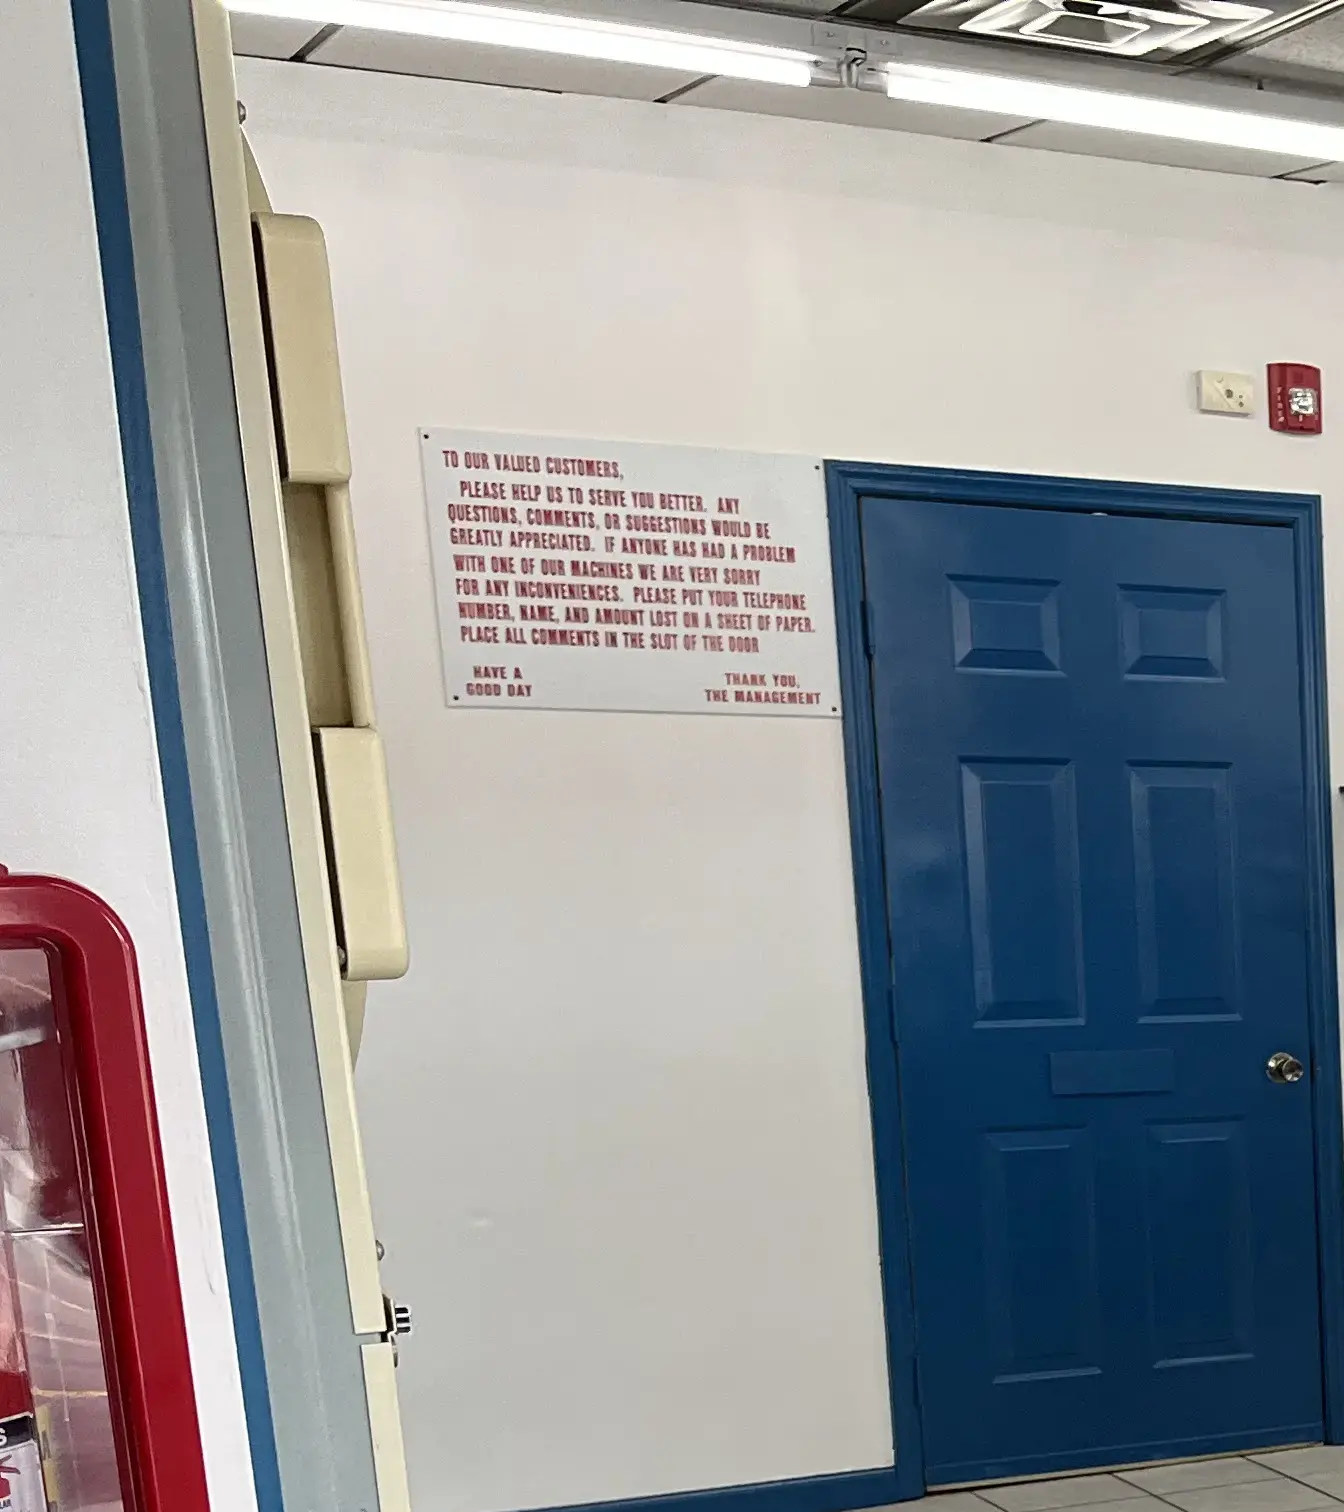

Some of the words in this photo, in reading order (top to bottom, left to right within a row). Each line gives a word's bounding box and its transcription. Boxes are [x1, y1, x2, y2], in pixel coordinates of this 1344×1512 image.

[442, 450, 458, 468] TO
[464, 451, 489, 470] OUR
[494, 453, 540, 473] VALUED
[545, 457, 623, 479] CUSTOMERS,
[459, 480, 506, 499] PLEASE
[511, 484, 542, 501] HELP
[546, 486, 563, 503] US
[568, 487, 582, 504] TO
[588, 489, 626, 507] SERVE
[631, 491, 654, 509] YOU
[659, 493, 707, 512] BETTER.
[716, 497, 740, 514] ANY
[447, 503, 522, 525] QUESTIONS,
[526, 508, 599, 529] COMMENTS,
[603, 513, 621, 530] OR
[625, 514, 706, 536] SUGGESTIONS
[711, 519, 751, 538] WOULD
[755, 522, 770, 539] BE
[449, 527, 503, 546] GREATLY
[509, 530, 595, 551] APPRECIATED.
[604, 536, 615, 553] IF
[620, 537, 667, 555] ANYONE
[672, 540, 696, 557] HAS
[701, 542, 725, 559] HAD
[730, 543, 738, 559] A
[742, 544, 795, 563] PROBLEM
[452, 554, 485, 571] WITH
[490, 556, 515, 573] ONE
[520, 557, 535, 574] OF
[540, 558, 565, 575] OUR
[570, 560, 633, 579] MACHINES
[638, 564, 656, 580] WE
[661, 565, 684, 582] ARE
[689, 566, 718, 583] VERY
[723, 568, 760, 586] SORRY
[455, 577, 479, 595] FOR
[484, 579, 509, 596] ANY
[514, 580, 623, 602] INCONVENIENCES.
[633, 586, 676, 604] PLEASE
[682, 589, 703, 605] PUT
[708, 590, 738, 607] YOUR
[743, 592, 806, 610] TELEPHONE
[458, 601, 514, 620] NUMBER,
[519, 604, 559, 622] NAME,
[563, 606, 589, 623] AND
[594, 608, 645, 626] AMOUNT
[650, 610, 677, 627] LOST
[683, 612, 699, 628] ON
[704, 613, 712, 629] A
[717, 613, 752, 630] SHEET
[757, 615, 771, 631] OF
[776, 616, 815, 633] PAPER.
[460, 624, 499, 643] PLACE
[504, 626, 526, 644] ALL
[531, 627, 599, 647] COMMENTS
[604, 631, 617, 647] IN
[622, 631, 644, 648] THE
[682, 634, 697, 650] OF
[702, 635, 723, 652] THE
[728, 636, 759, 653] DOOR
[472, 665, 507, 678] HAVE
[512, 666, 522, 679] A
[725, 673, 766, 686] THANK
[772, 674, 799, 688] YOU,
[465, 682, 501, 696] GOOD
[507, 684, 532, 697] DAY
[705, 689, 728, 702] THE
[733, 690, 821, 705] MANAGEMENT
